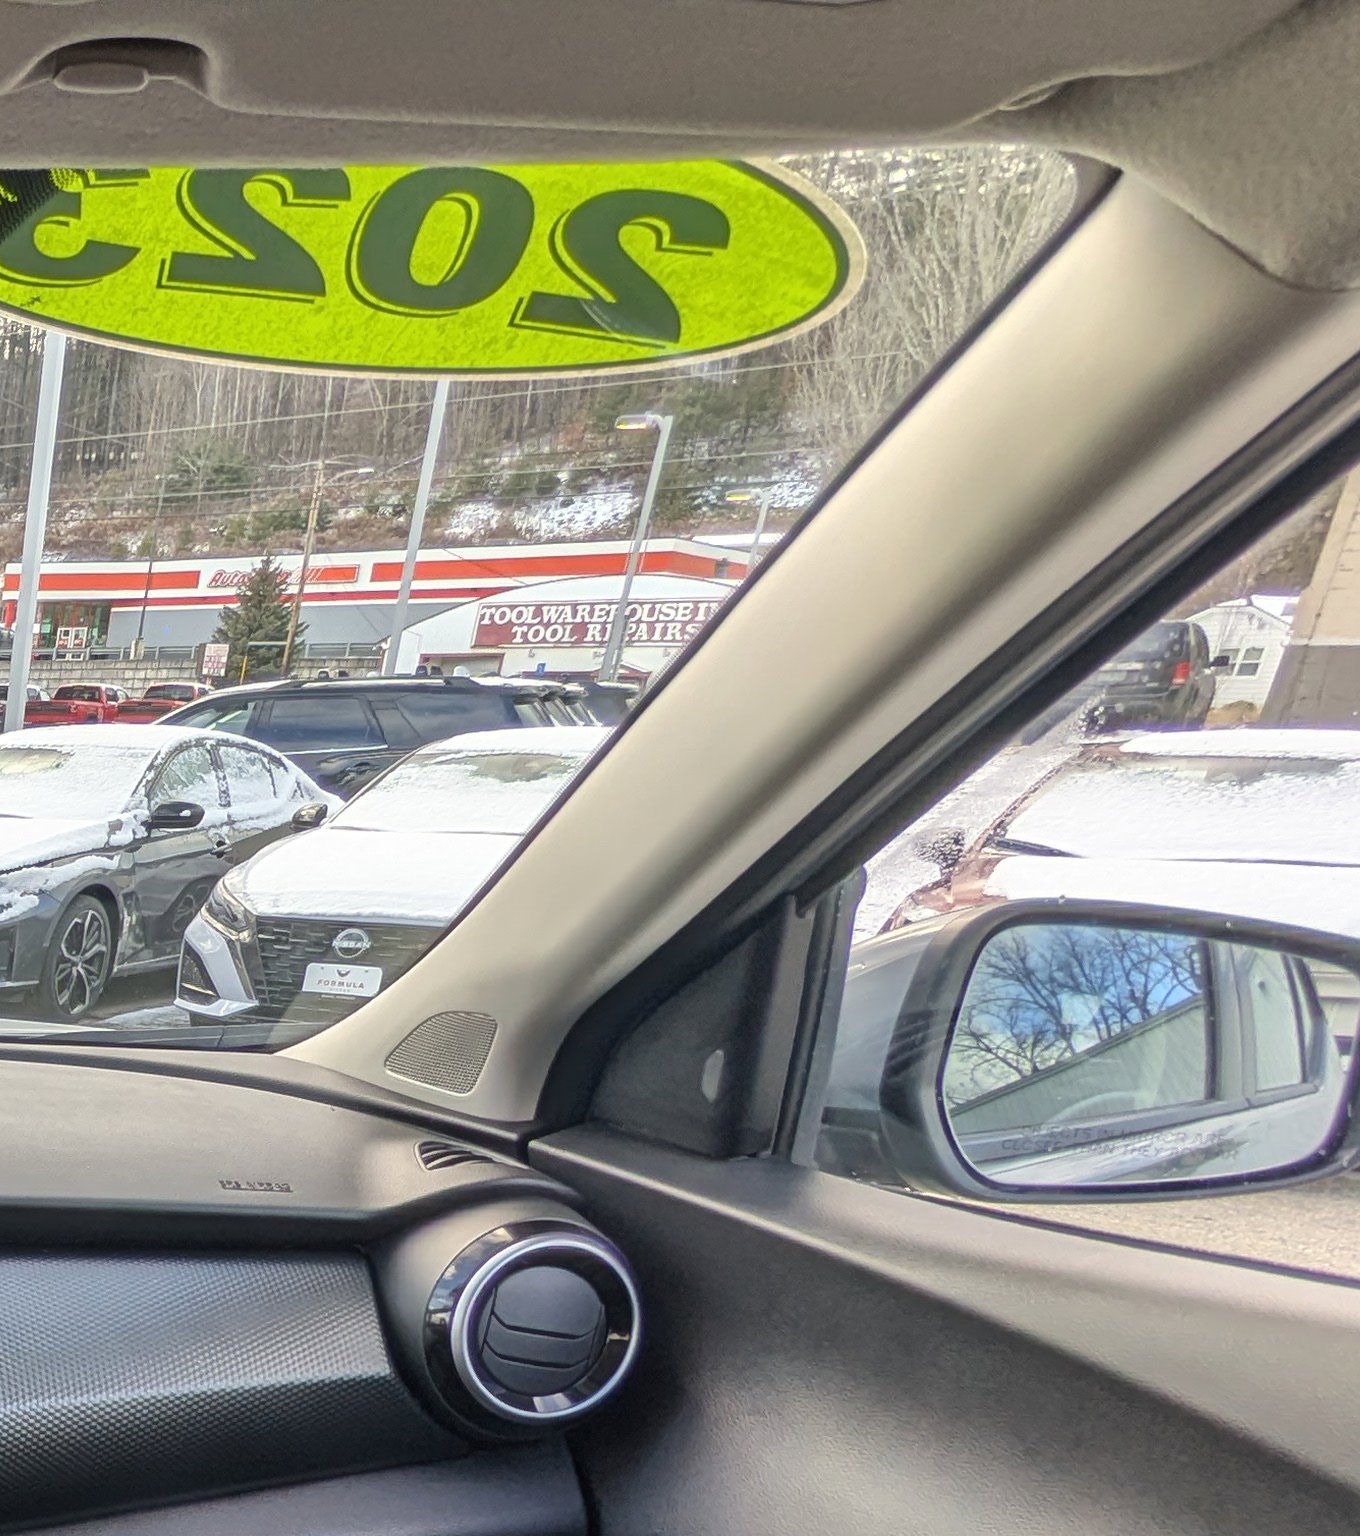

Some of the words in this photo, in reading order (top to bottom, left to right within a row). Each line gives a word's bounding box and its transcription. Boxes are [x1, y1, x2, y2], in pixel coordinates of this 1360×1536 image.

[480, 604, 541, 625] TOOL
[511, 624, 578, 643] TOOL
[317, 979, 366, 989] FORMULA
